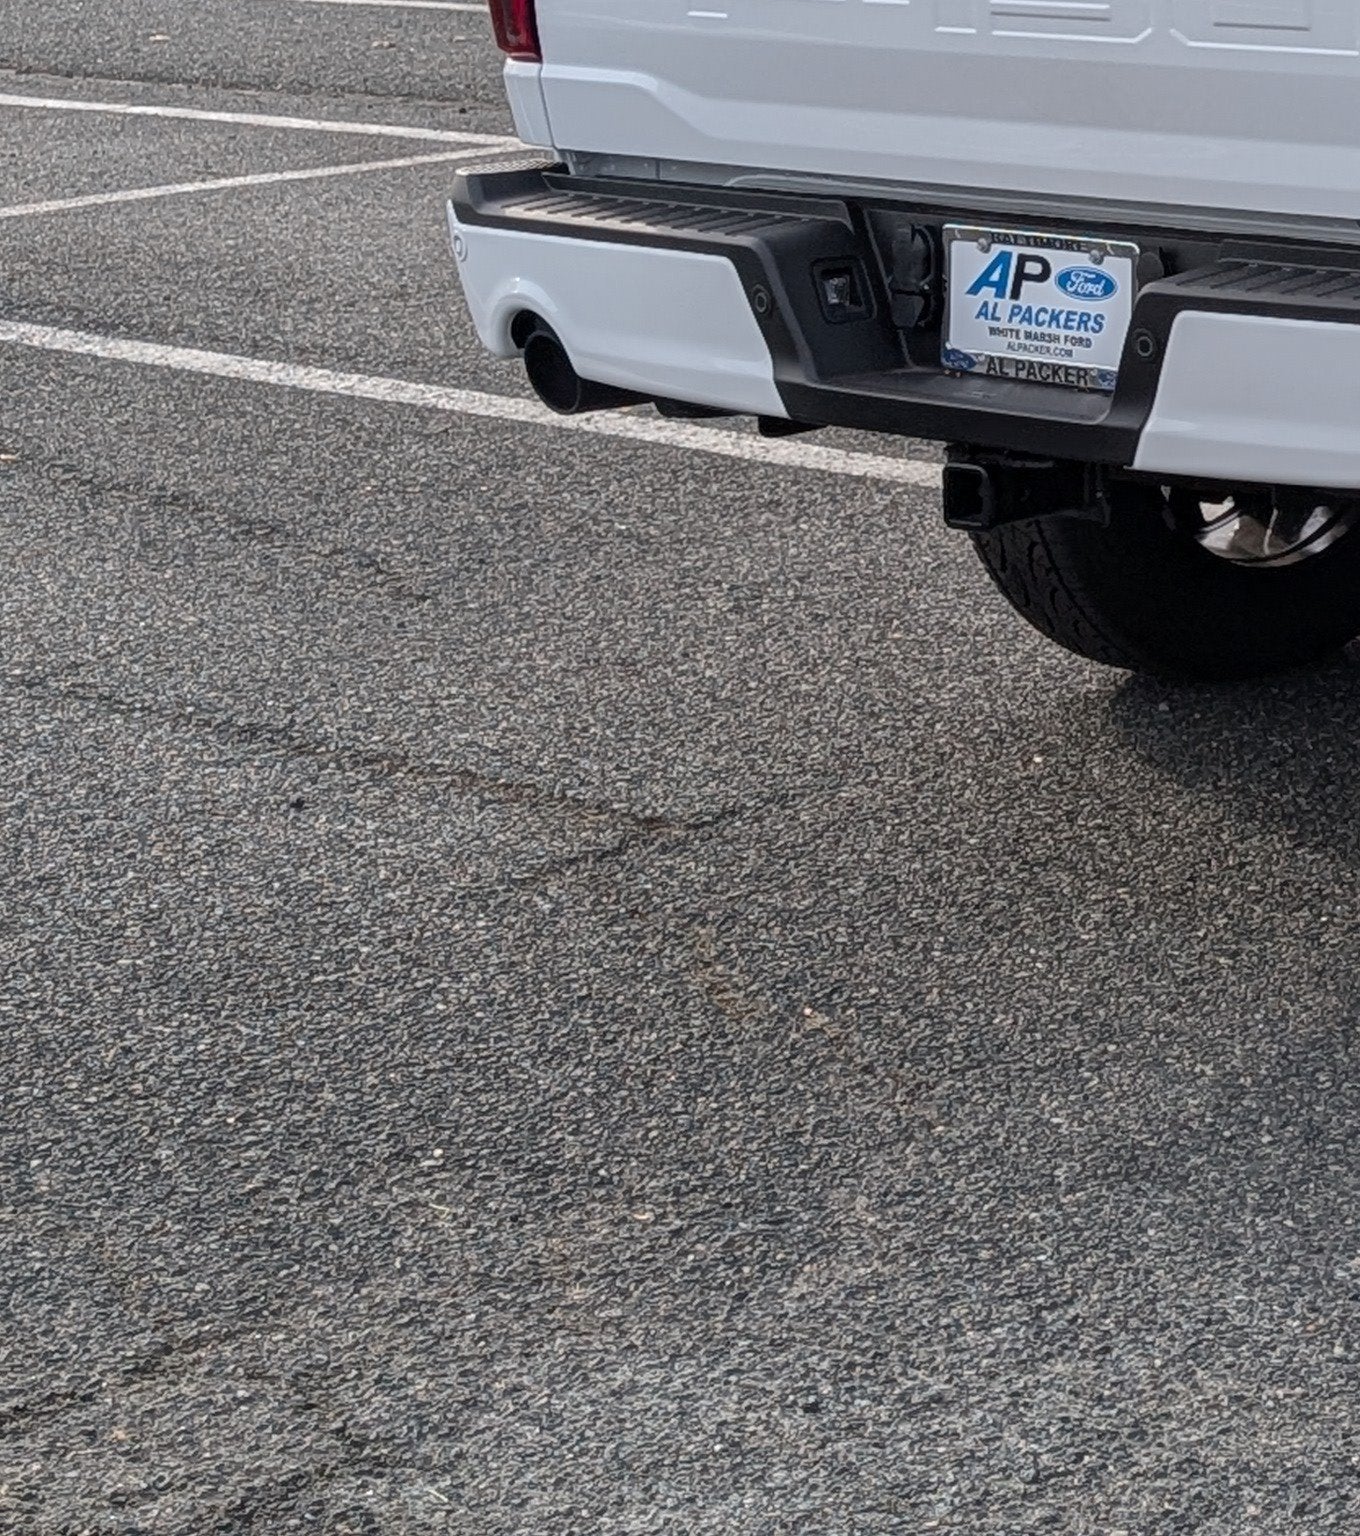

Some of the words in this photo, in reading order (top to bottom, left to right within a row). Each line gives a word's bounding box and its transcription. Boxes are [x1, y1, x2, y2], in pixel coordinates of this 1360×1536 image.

[965, 250, 1052, 302] AP
[975, 300, 1002, 323] AL
[1007, 304, 1107, 335] PACKERS
[988, 325, 1022, 342] WHITE
[1024, 329, 1062, 345] MARSH
[1063, 333, 1093, 349] FORD
[985, 356, 1010, 376] AL
[1014, 361, 1089, 387] PACKER
